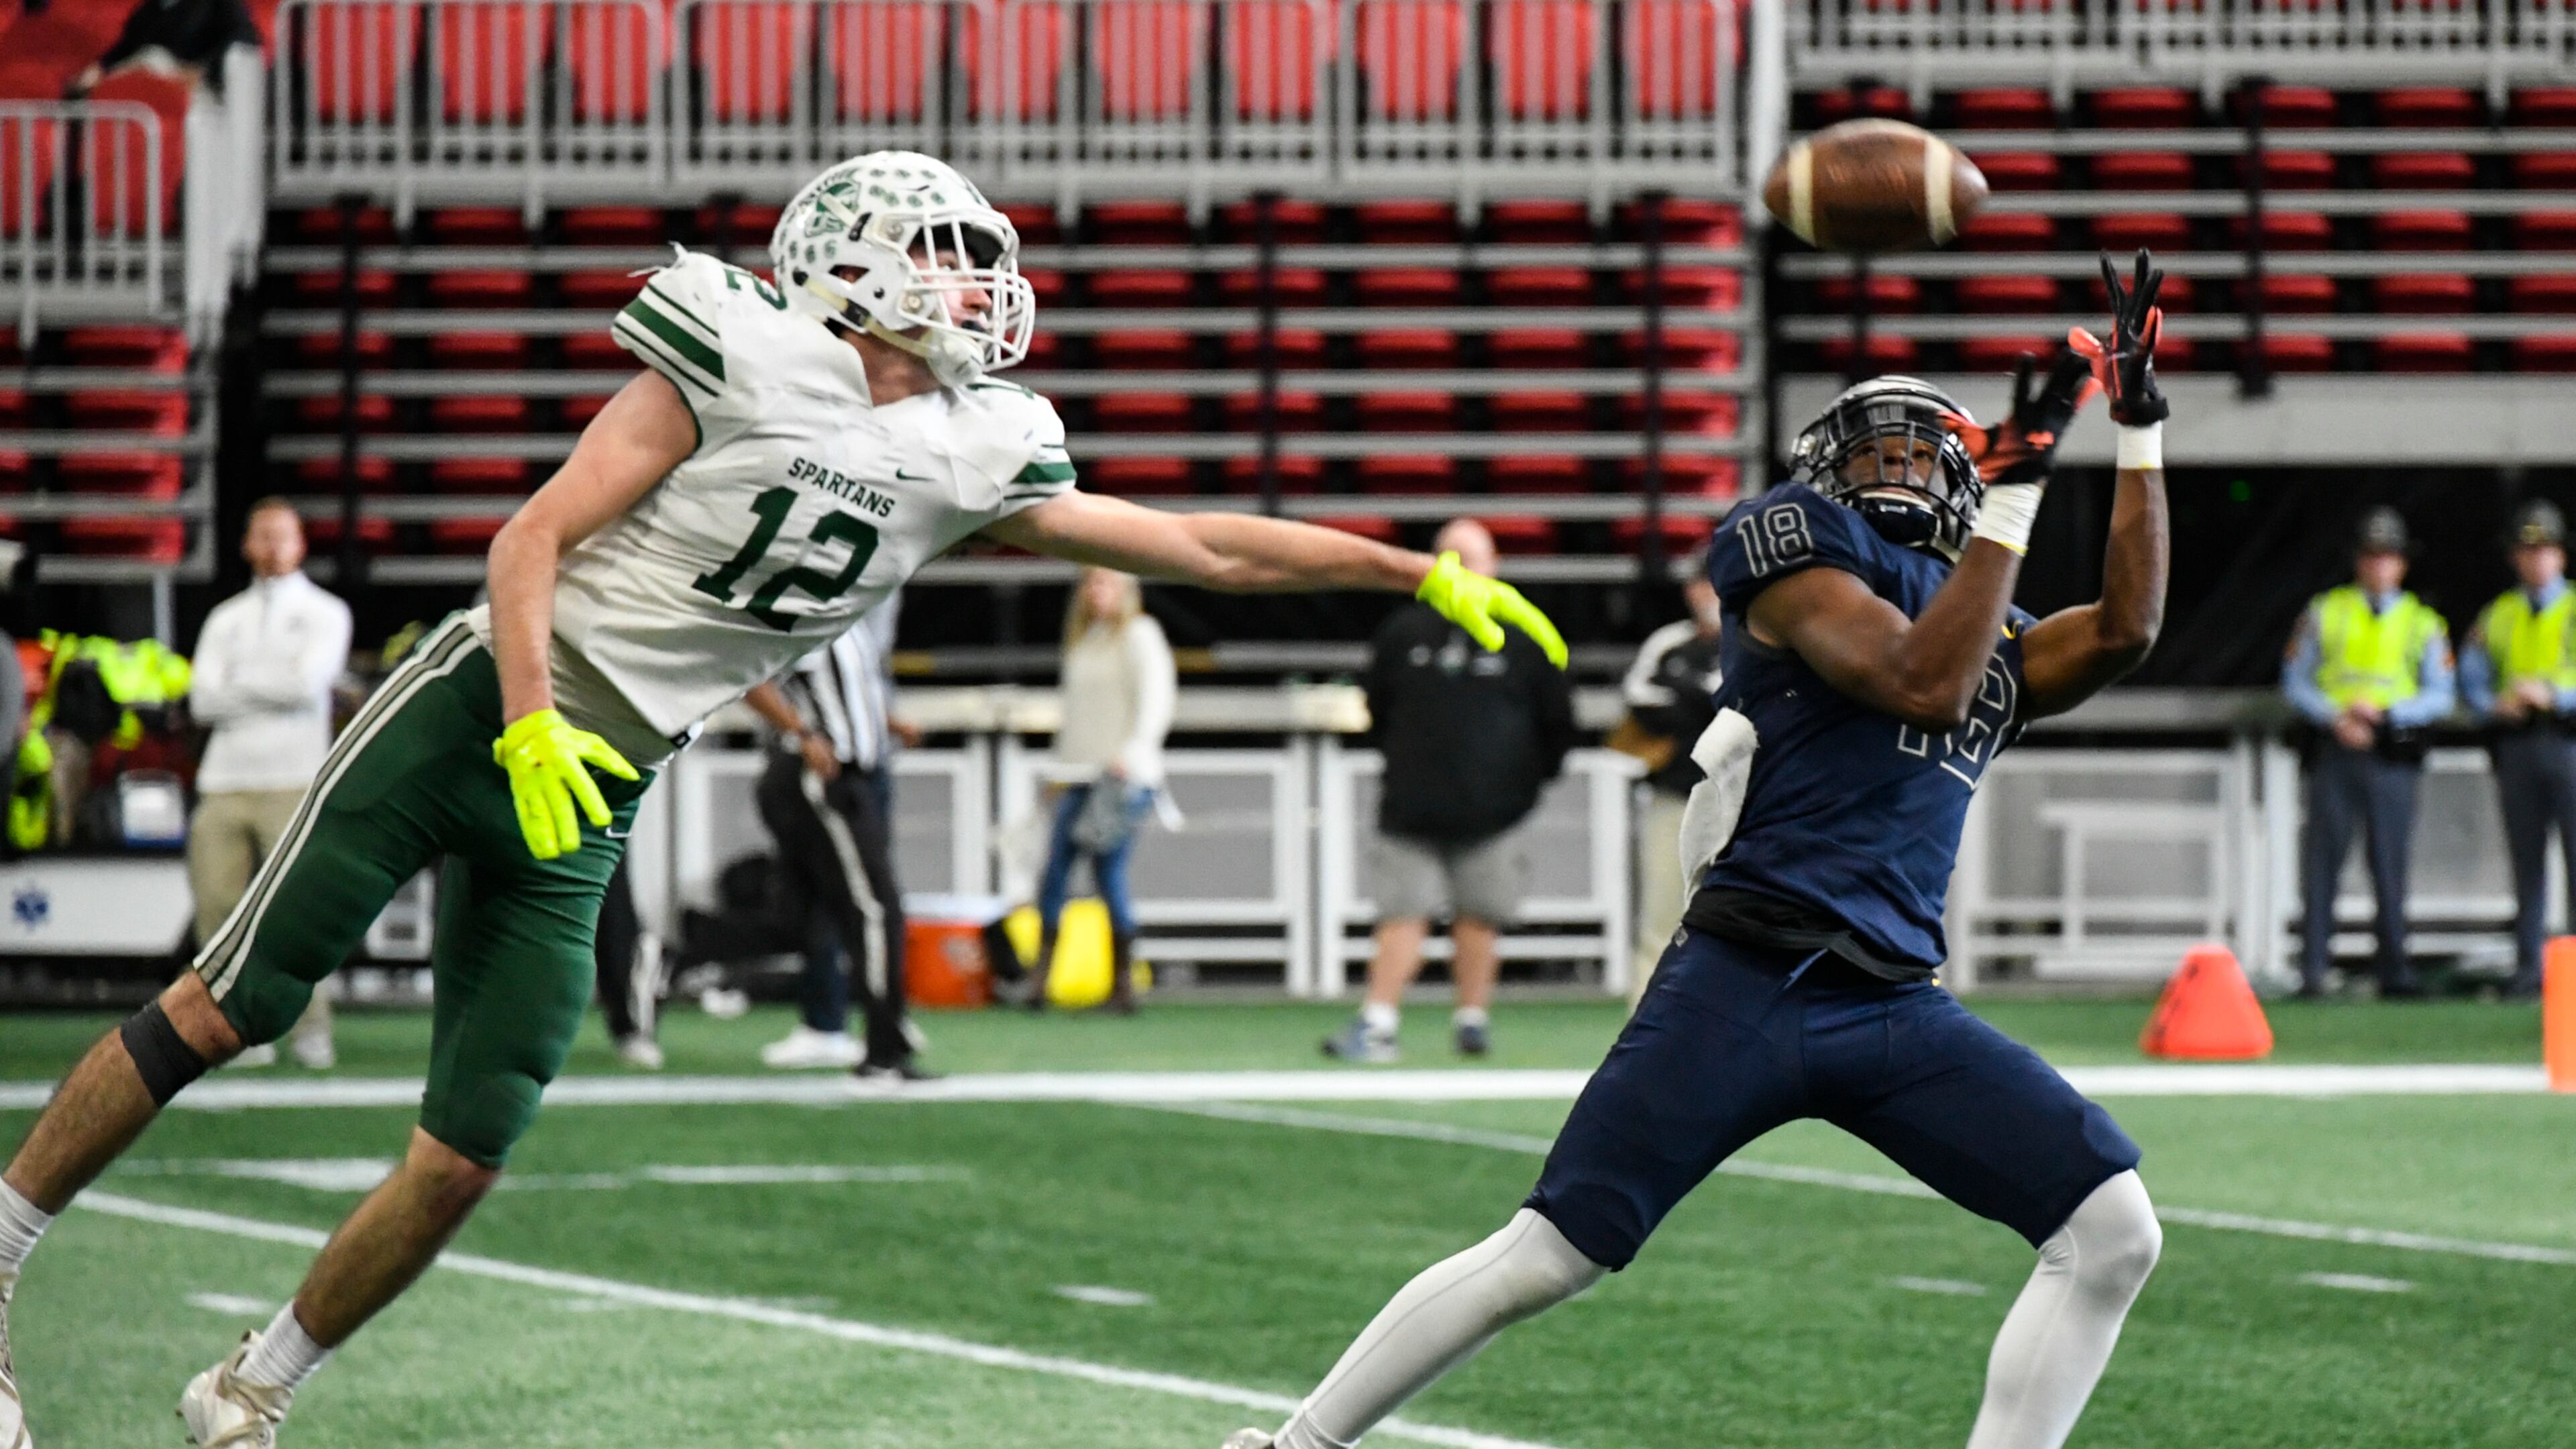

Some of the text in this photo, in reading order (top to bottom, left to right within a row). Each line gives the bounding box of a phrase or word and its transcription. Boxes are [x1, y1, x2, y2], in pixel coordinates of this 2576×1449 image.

[787, 456, 896, 518] SPARTANS
[691, 485, 879, 633] 12
[1735, 502, 1813, 578] 18
